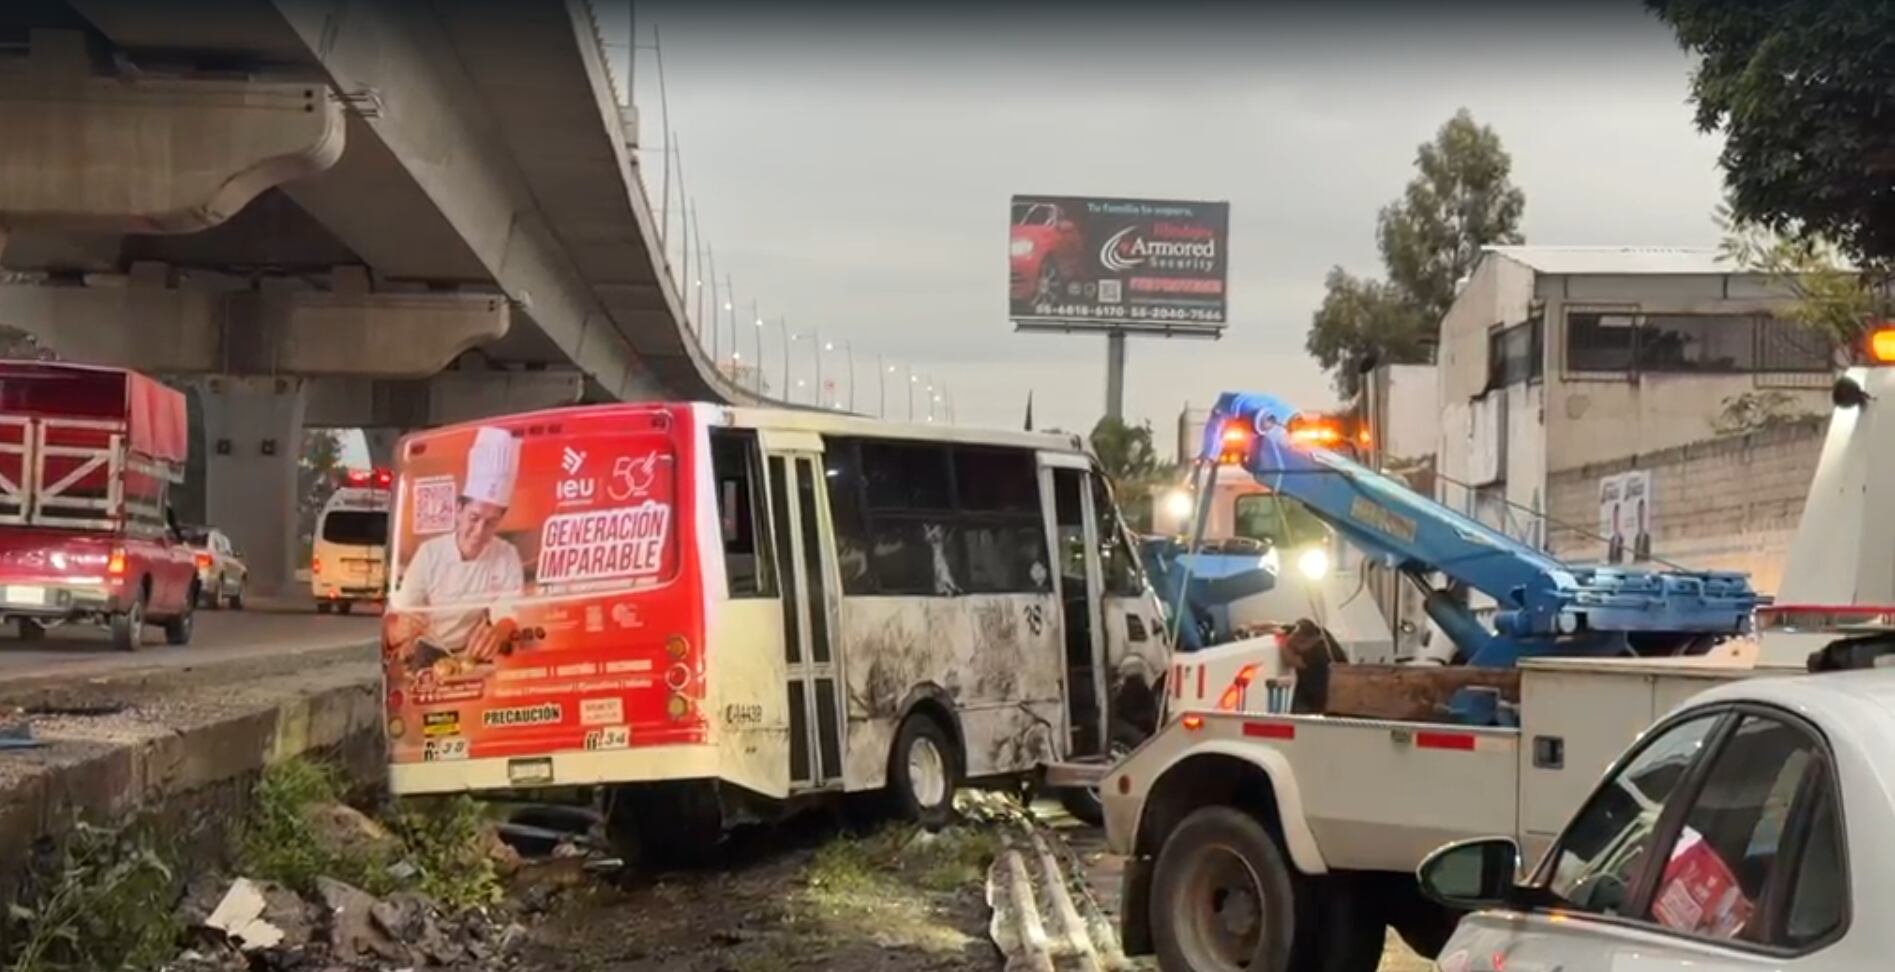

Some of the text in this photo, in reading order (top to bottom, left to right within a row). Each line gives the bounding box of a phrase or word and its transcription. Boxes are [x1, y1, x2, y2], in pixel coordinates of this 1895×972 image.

[1129, 237, 1215, 257] Armored
[1151, 257, 1215, 272] Security
[545, 503, 665, 548] GENERACIÓN
[540, 540, 659, 579] IMPARABLE
[483, 703, 561, 725] PRECAUCIÓN
